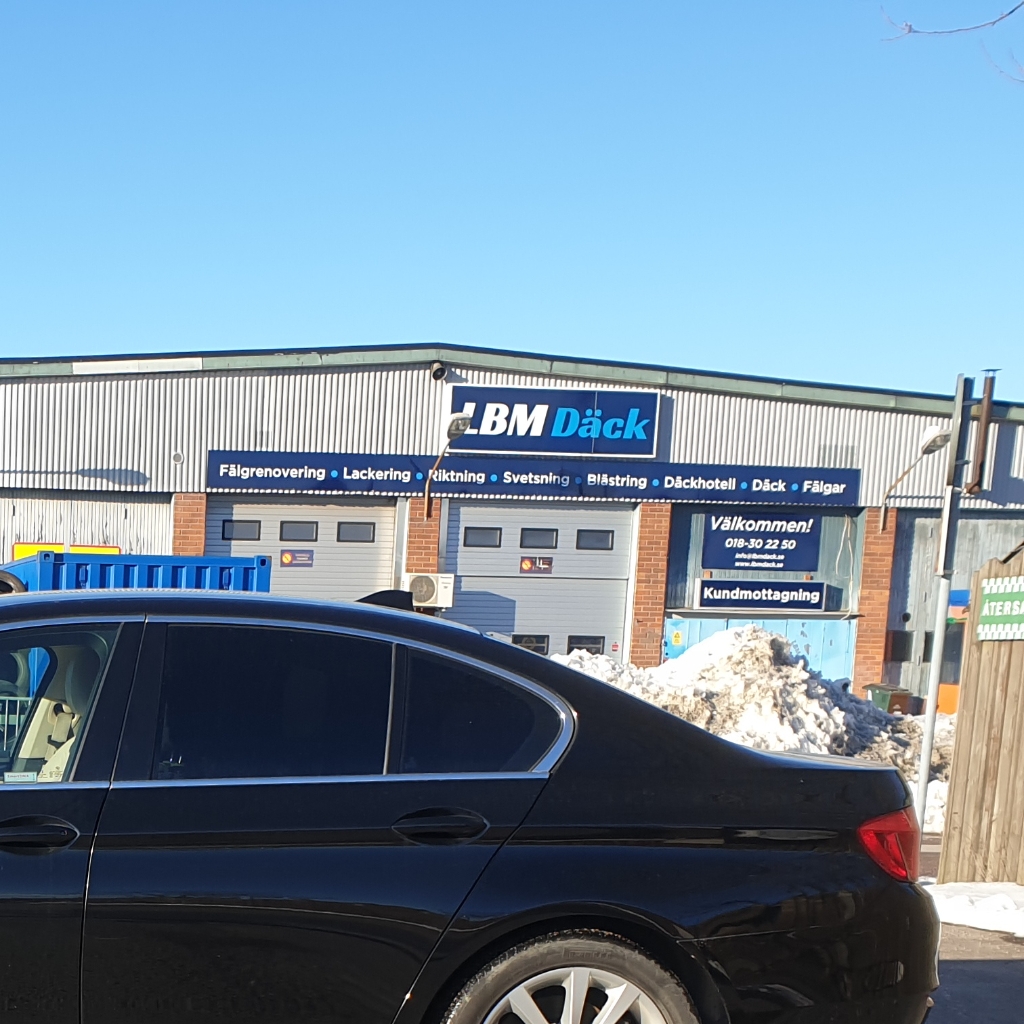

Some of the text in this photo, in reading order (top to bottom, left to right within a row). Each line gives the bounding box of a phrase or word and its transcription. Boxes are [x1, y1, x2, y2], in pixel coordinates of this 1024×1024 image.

[464, 402, 650, 440] LBM Däck
[219, 464, 846, 495] Fälgrenovering Lackering Riktning Svetsning Blästring Däckhotell Däck Fälgar
[711, 515, 814, 533] Välkommen!
[725, 538, 796, 550] 018-30 22 50
[703, 587, 821, 604] Kundmottagning
